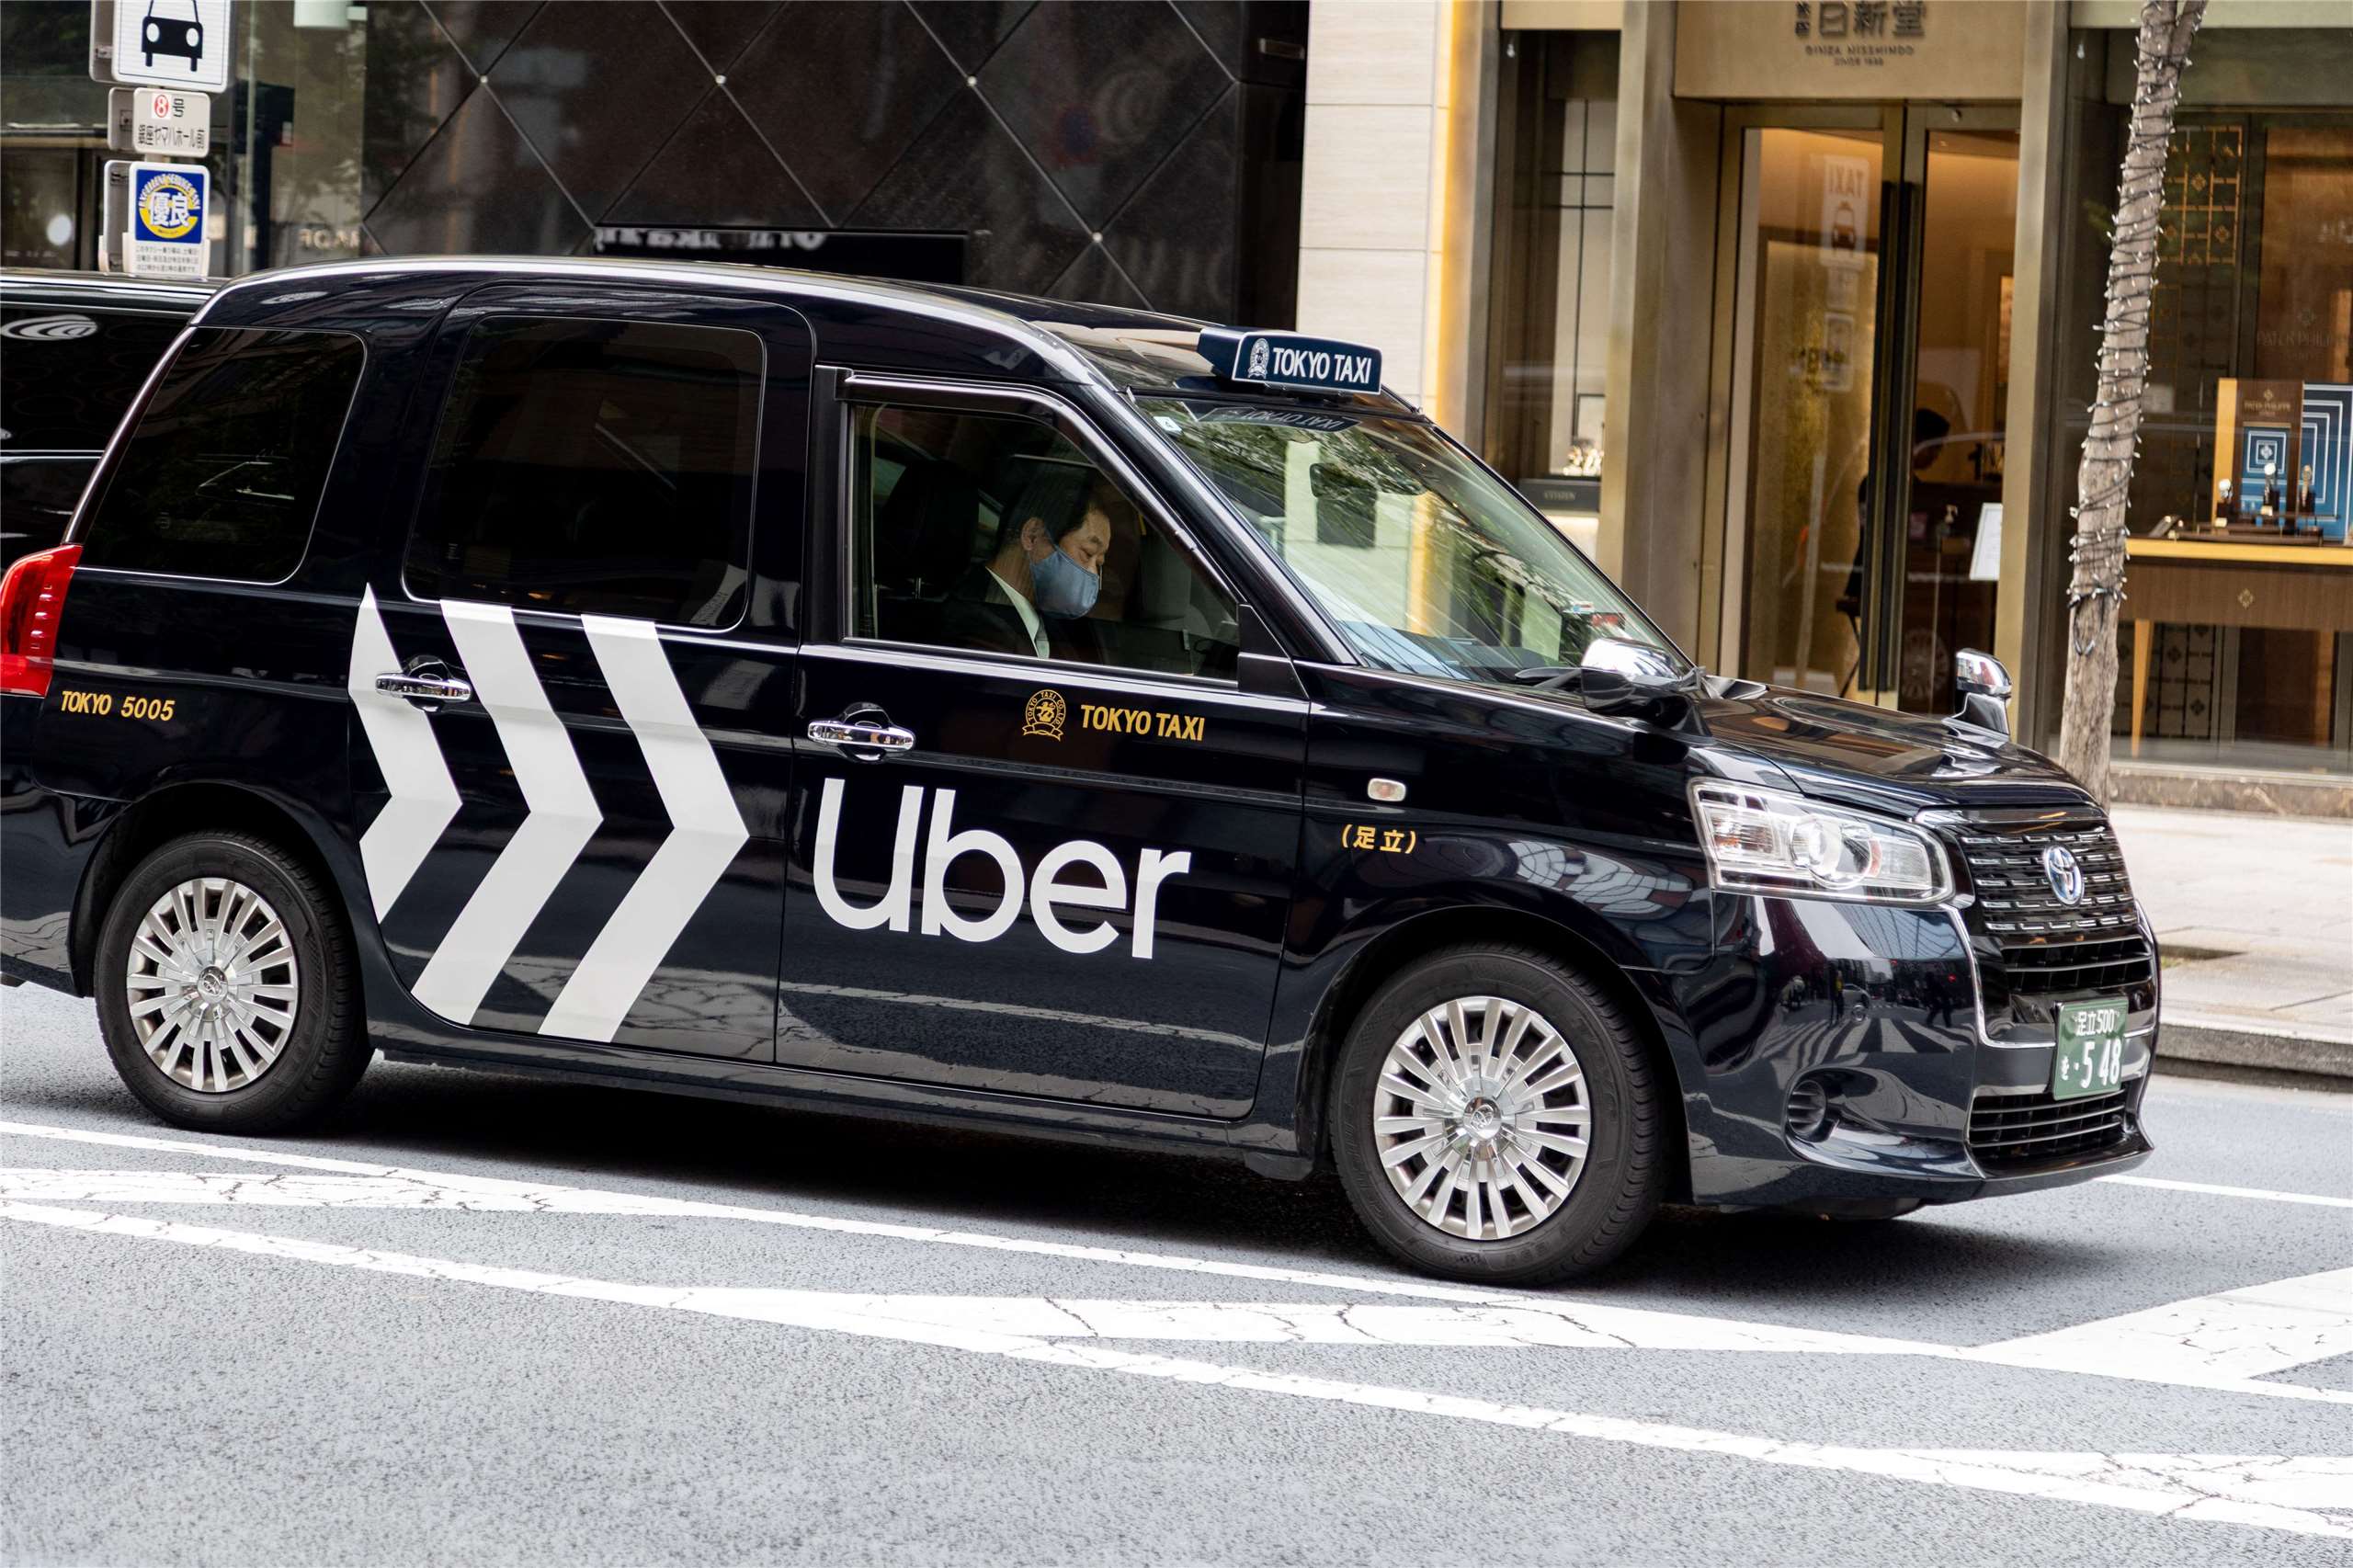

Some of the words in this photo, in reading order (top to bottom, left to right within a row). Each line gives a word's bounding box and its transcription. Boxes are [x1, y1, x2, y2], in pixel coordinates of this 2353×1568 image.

[1272, 347, 1331, 381] TOKYO
[1334, 354, 1373, 384] TAXI
[61, 690, 112, 716] TOKYO
[120, 696, 176, 722] 5005
[1080, 704, 1152, 735] TOKYO
[1155, 712, 1205, 742] TAXI
[813, 778, 1191, 960] Uber
